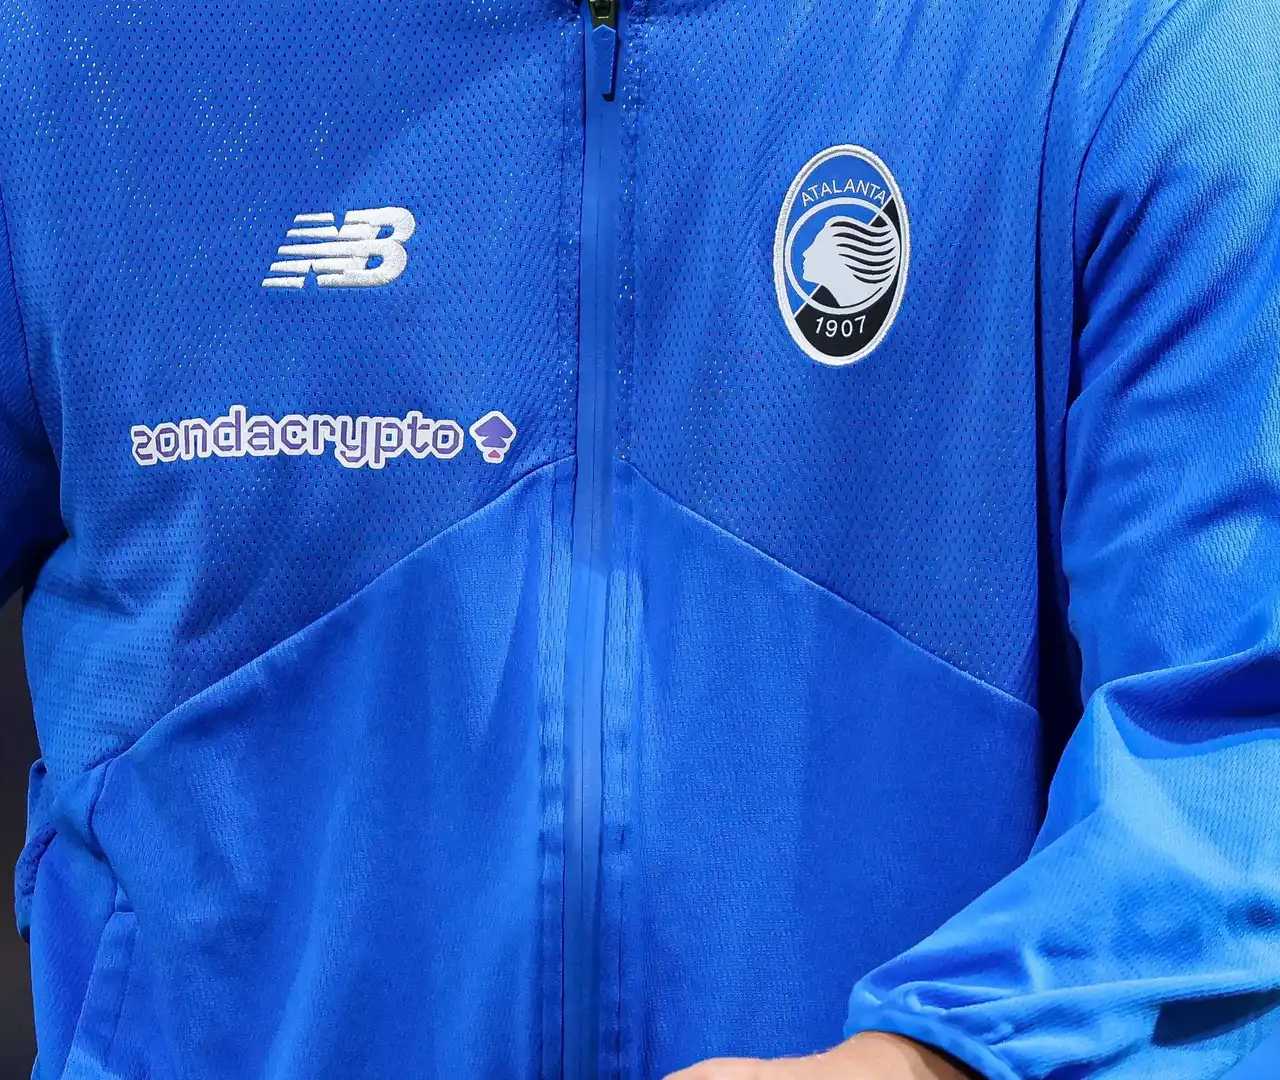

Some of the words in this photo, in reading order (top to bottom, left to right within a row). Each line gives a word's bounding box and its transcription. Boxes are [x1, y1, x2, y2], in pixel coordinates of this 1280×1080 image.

[802, 179, 886, 206] ATALANTA
[262, 207, 415, 288] NB
[816, 315, 866, 337] 1907
[132, 406, 464, 469] zondacrypto
